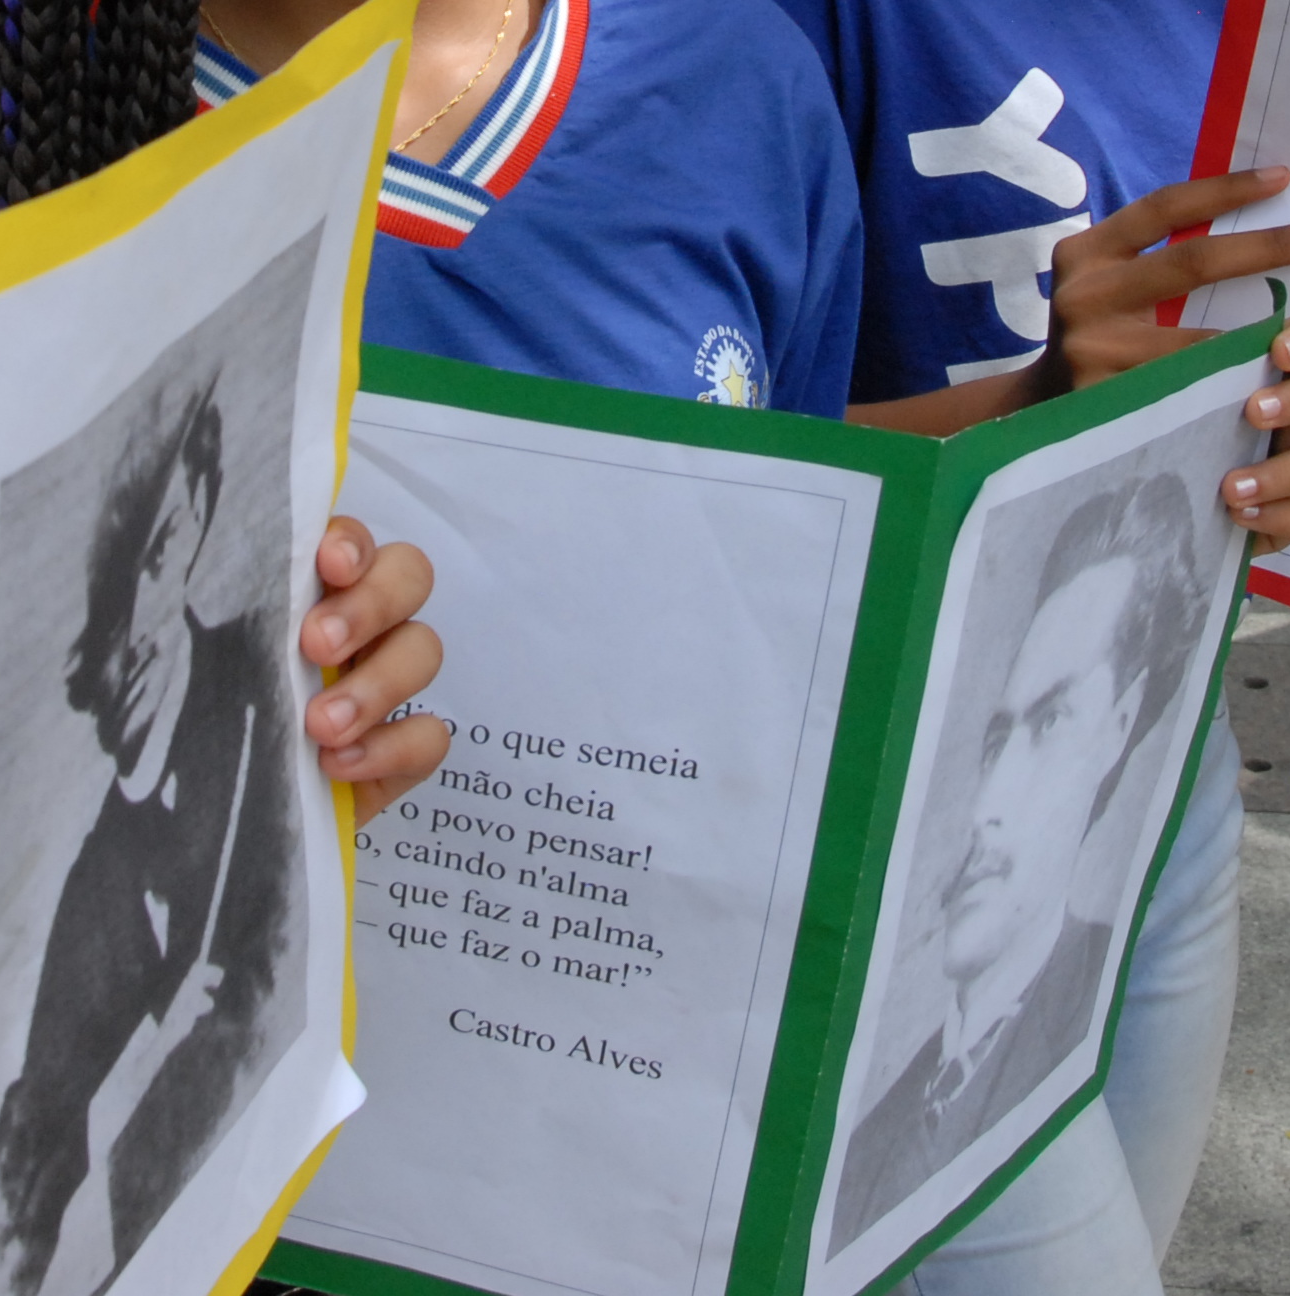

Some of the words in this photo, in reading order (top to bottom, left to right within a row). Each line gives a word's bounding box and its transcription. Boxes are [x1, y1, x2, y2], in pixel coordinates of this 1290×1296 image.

[693, 327, 718, 377] ESTADO
[716, 324, 733, 337] DA
[469, 723, 491, 745] o
[502, 729, 567, 760] que
[576, 741, 700, 780] semeia
[439, 766, 514, 801] mão
[524, 782, 616, 822] cheia
[394, 839, 507, 880] caindo
[399, 800, 420, 821] o
[430, 806, 516, 844] povo
[526, 828, 654, 873] pensar!
[387, 920, 449, 948] que
[459, 928, 510, 963] faz
[520, 948, 541, 969] o
[388, 879, 450, 909] que
[461, 888, 513, 924] faz
[521, 908, 540, 929] a
[549, 914, 665, 959] palma,
[448, 1008, 556, 1054] Castro
[567, 1035, 664, 1081] Alves
